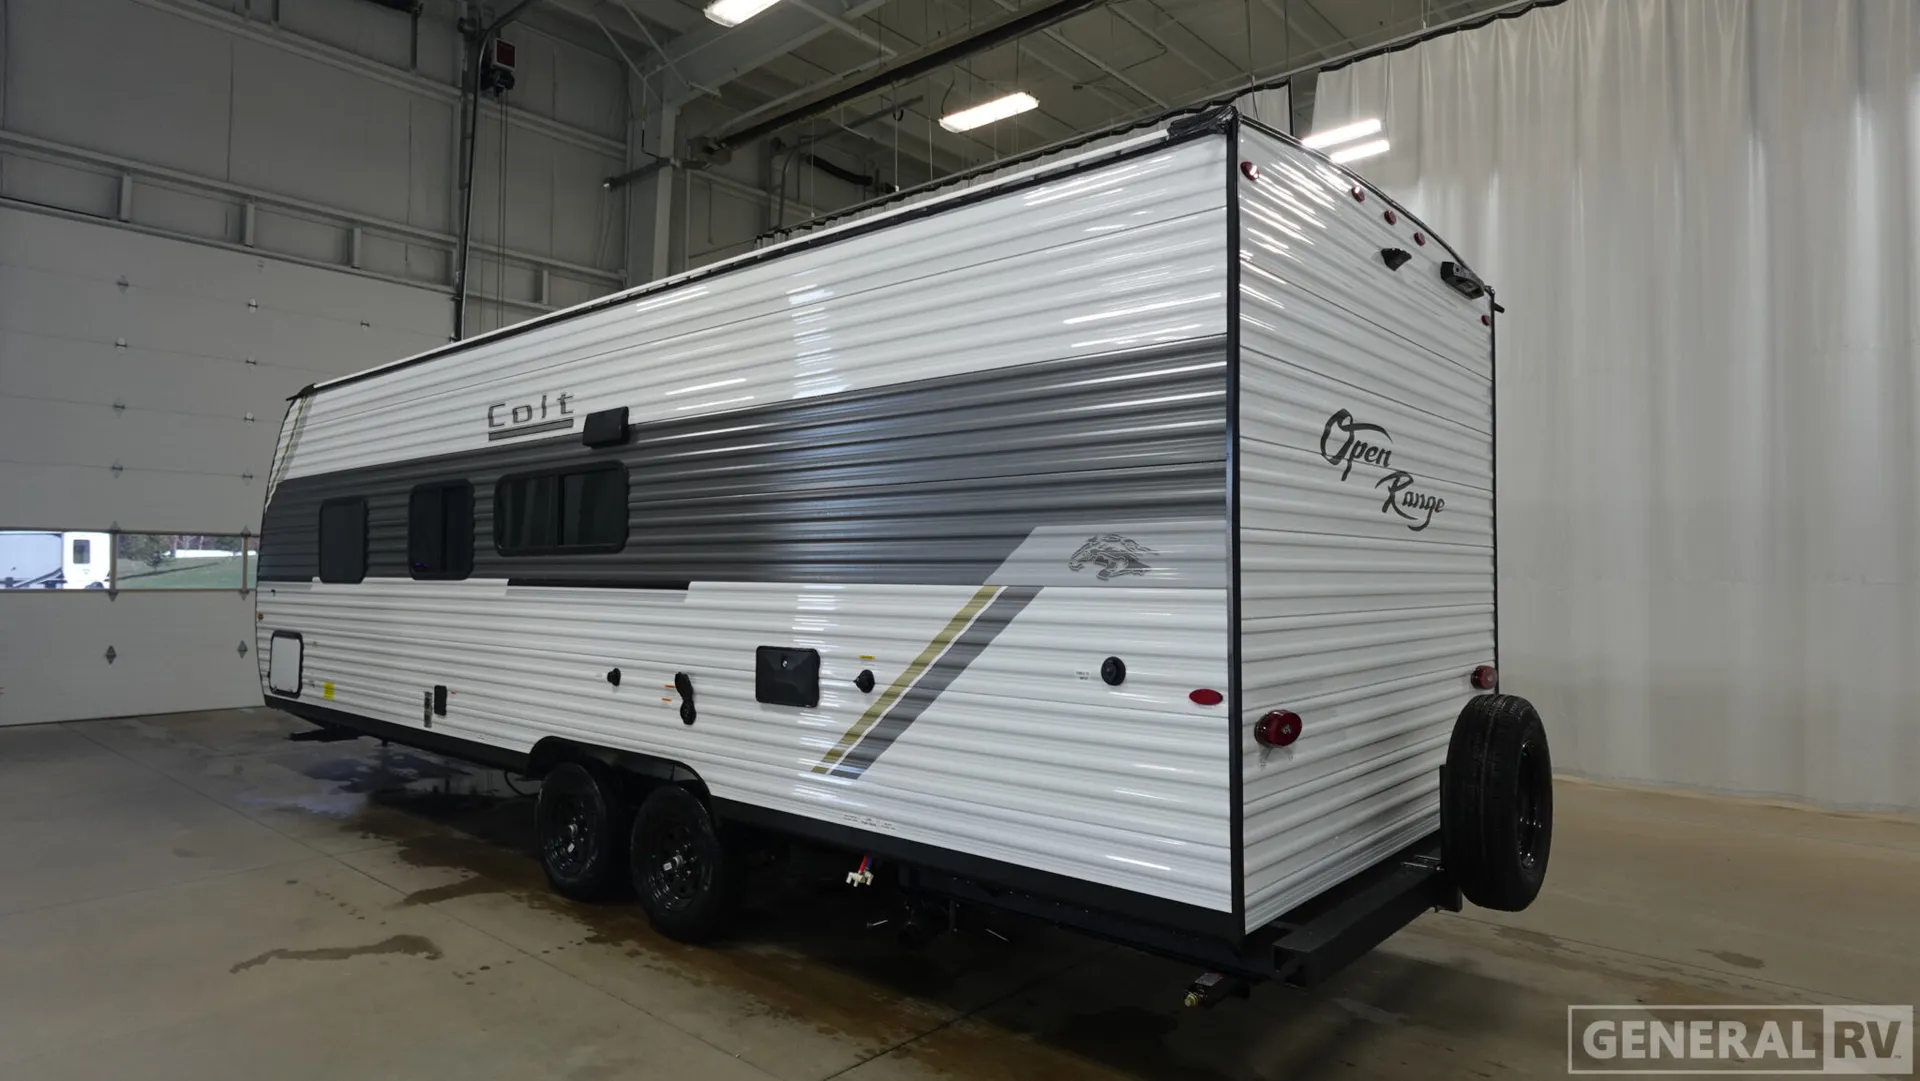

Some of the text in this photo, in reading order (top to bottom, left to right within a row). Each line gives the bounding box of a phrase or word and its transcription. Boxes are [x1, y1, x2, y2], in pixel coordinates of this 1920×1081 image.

[488, 393, 574, 428] Colt
[1320, 408, 1394, 481] Open
[1375, 470, 1445, 531] Range
